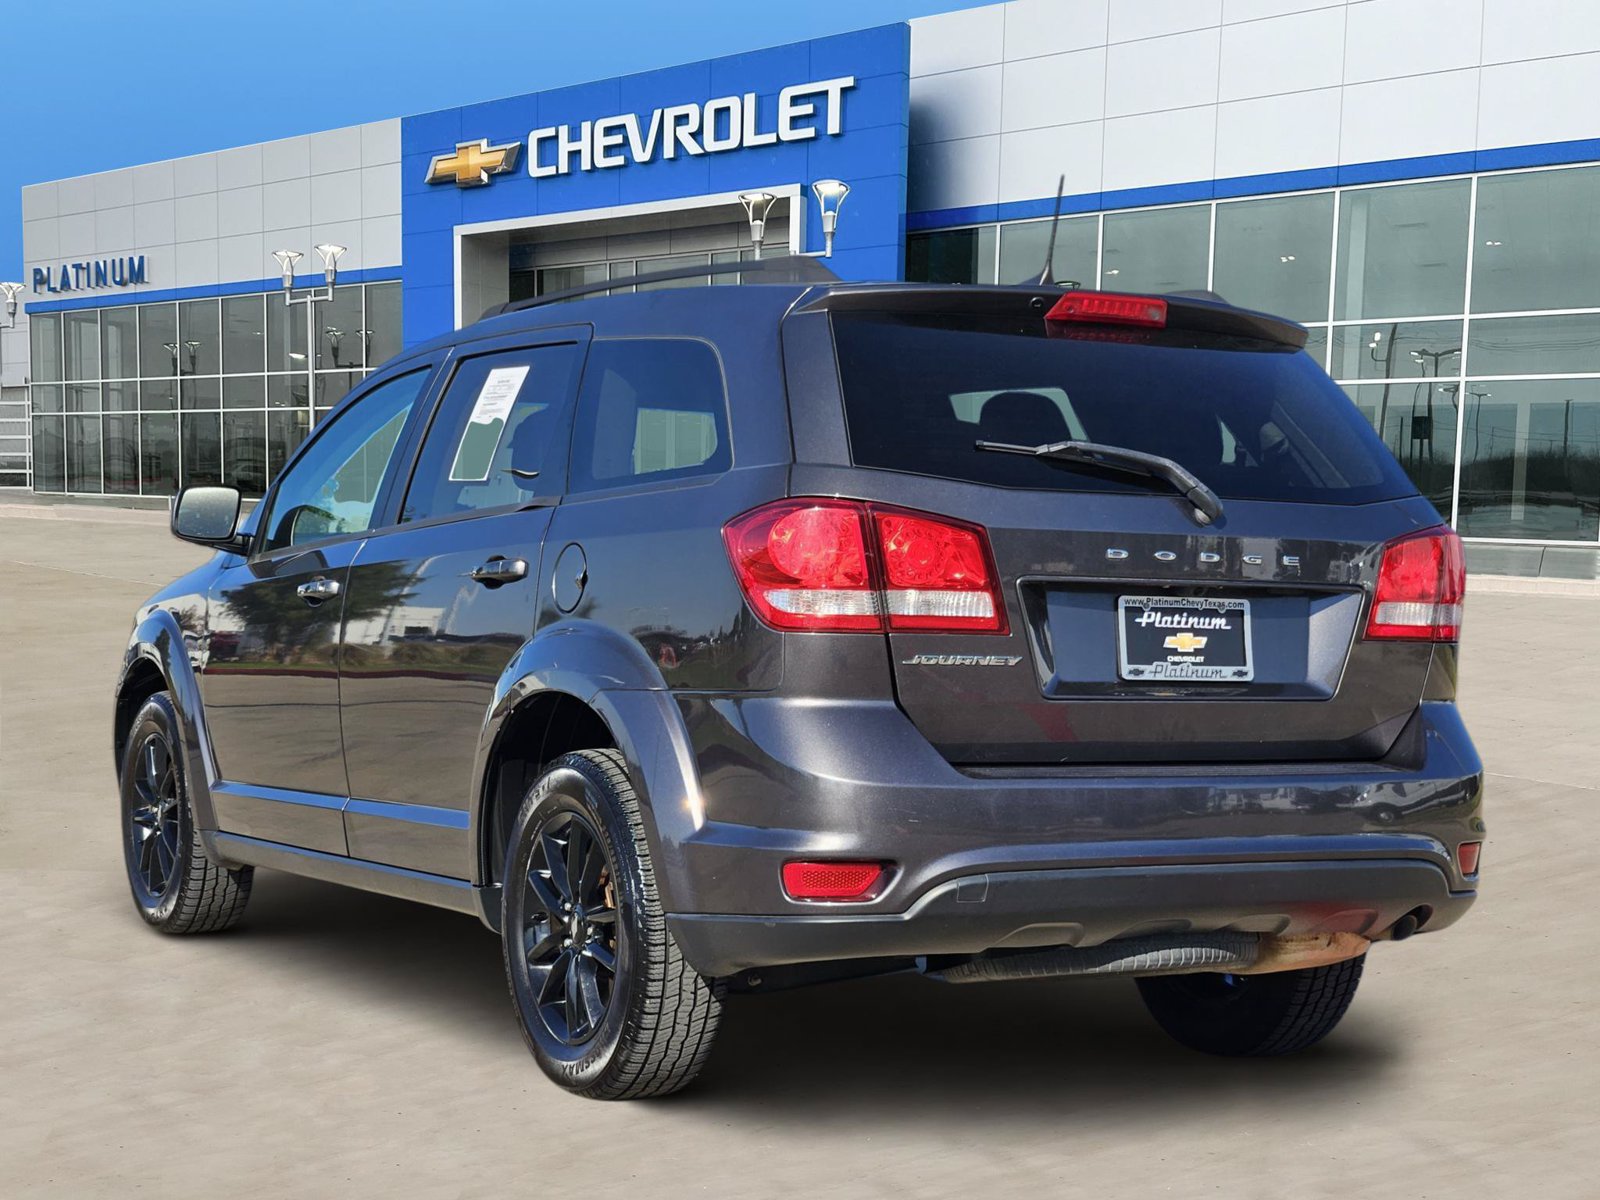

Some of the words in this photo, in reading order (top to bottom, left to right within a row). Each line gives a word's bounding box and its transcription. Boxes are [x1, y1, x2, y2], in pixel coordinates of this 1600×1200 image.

[528, 76, 855, 178] CHEVROLET
[33, 255, 146, 294] PLATINUM
[1106, 548, 1300, 566] DODGE
[1124, 597, 1245, 610] www.PlatinumChevyTexas.com
[1135, 611, 1232, 630] Platinum
[902, 654, 1023, 666] JOURNEY
[1167, 655, 1205, 663] CHEVROLET
[1149, 662, 1228, 679] Platinum
